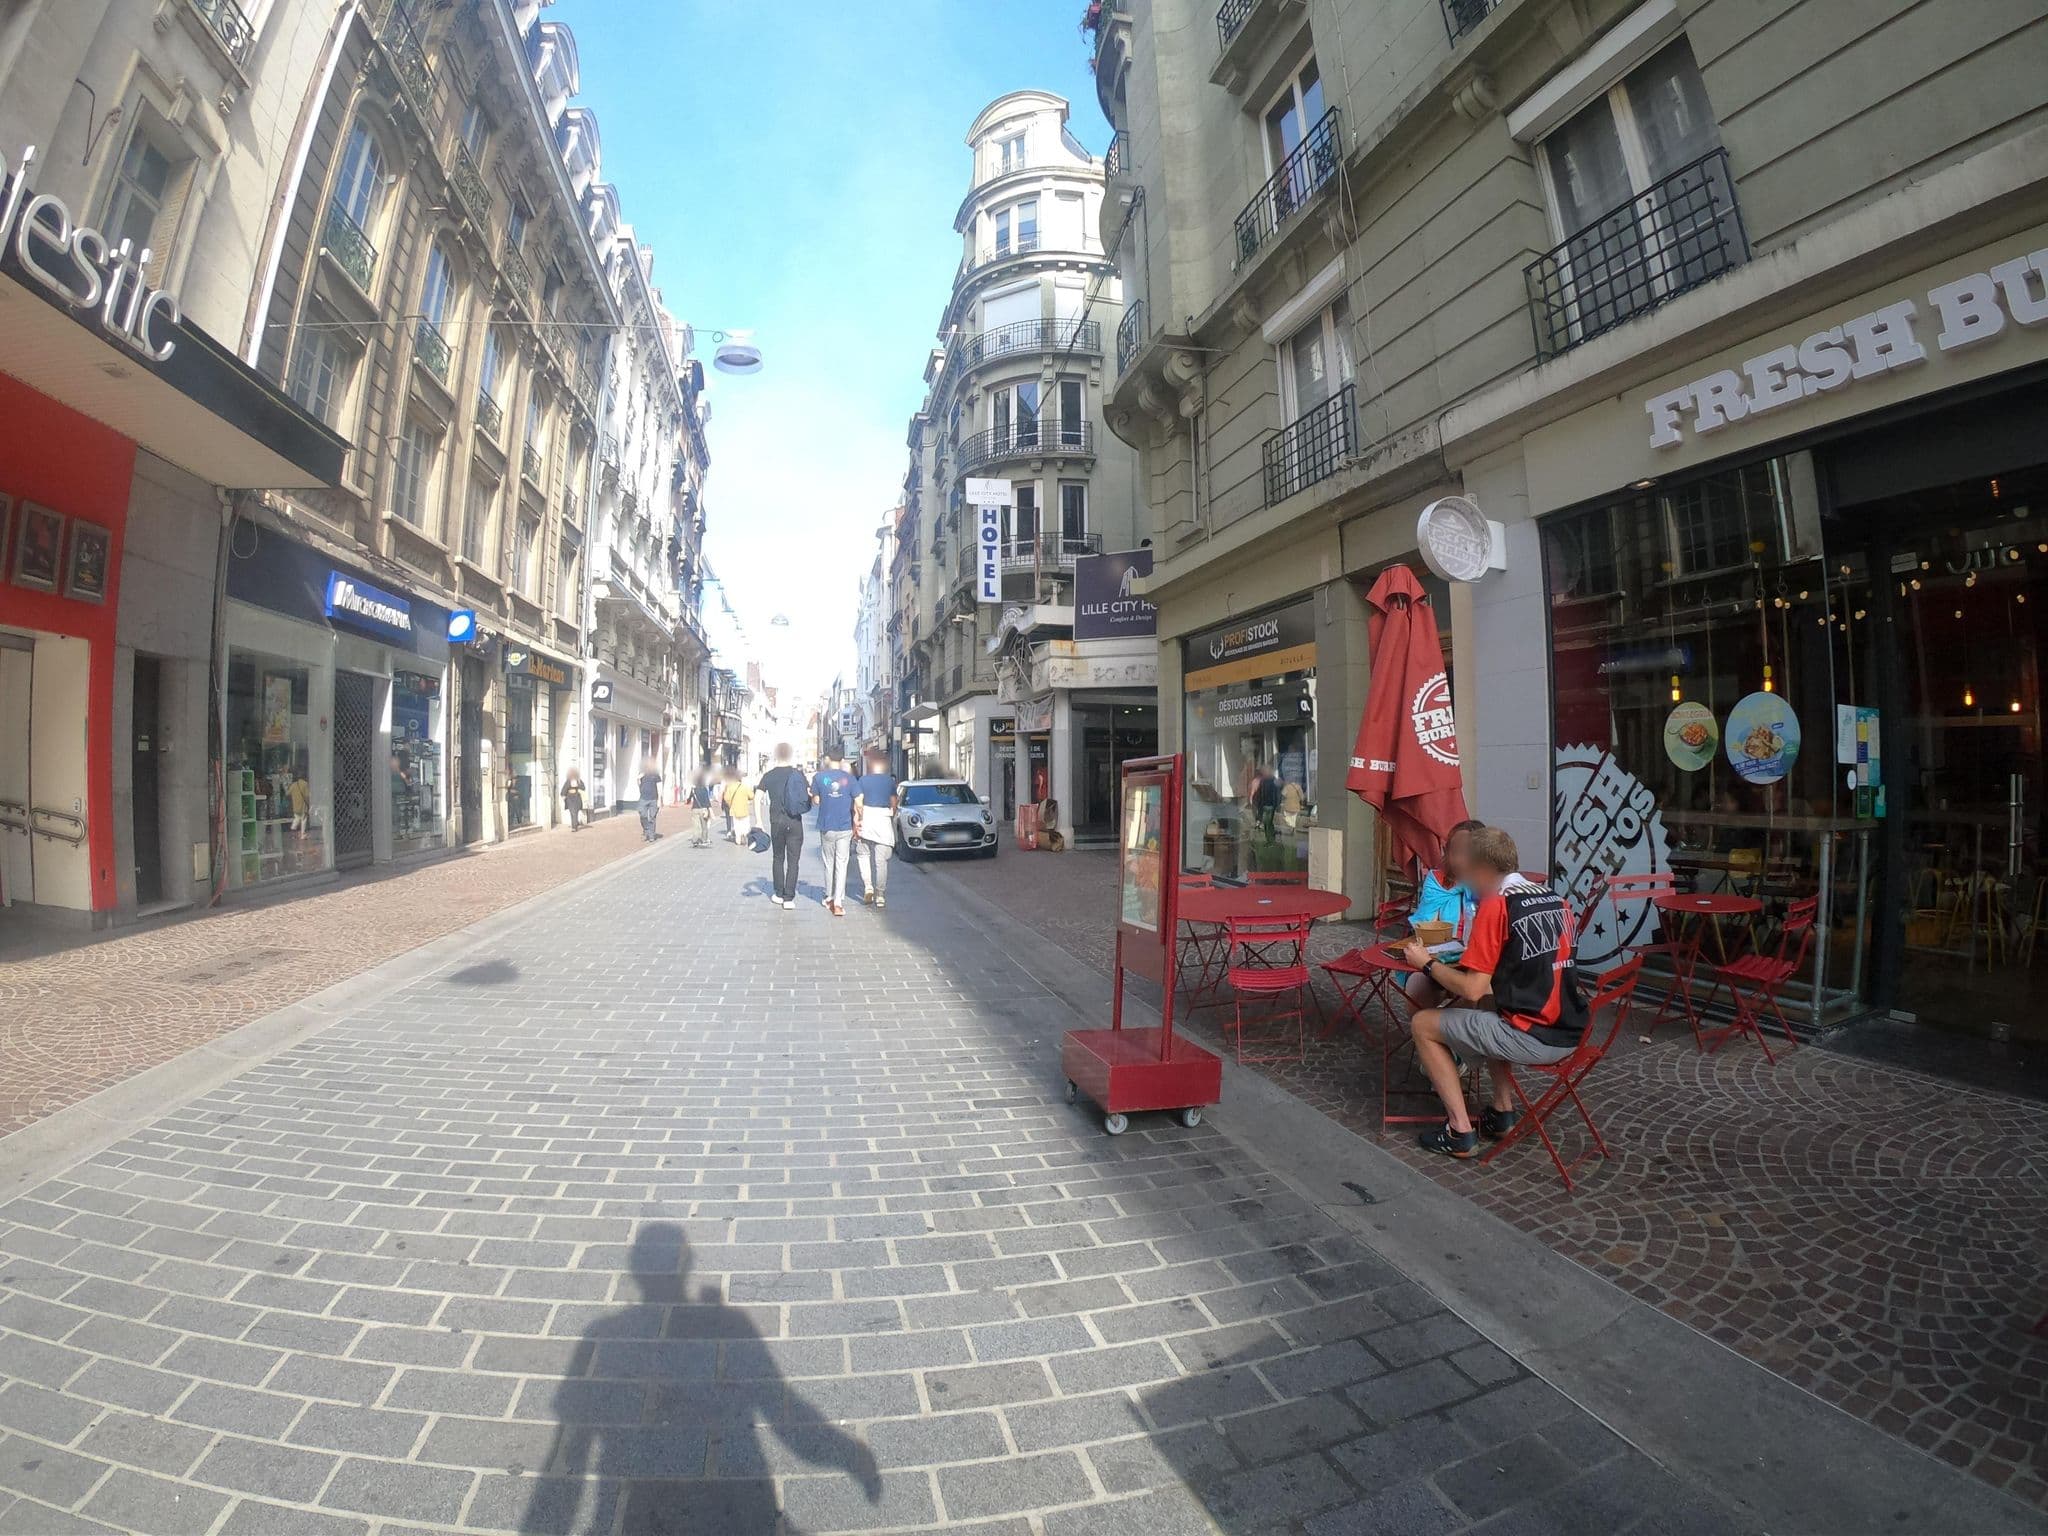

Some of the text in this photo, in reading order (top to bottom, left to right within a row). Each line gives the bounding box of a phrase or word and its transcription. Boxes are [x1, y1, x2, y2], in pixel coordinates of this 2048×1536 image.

[1645, 299, 1928, 449] FRESH
[981, 508, 998, 598] HOTEL
[1081, 602, 1109, 616] LILLE
[1111, 600, 1138, 613] CITY
[1223, 619, 1279, 649] PROFISTOCK
[593, 685, 610, 699] JD
[1262, 693, 1273, 706] DE
[1213, 709, 1278, 728] GRANDES MARQUES
